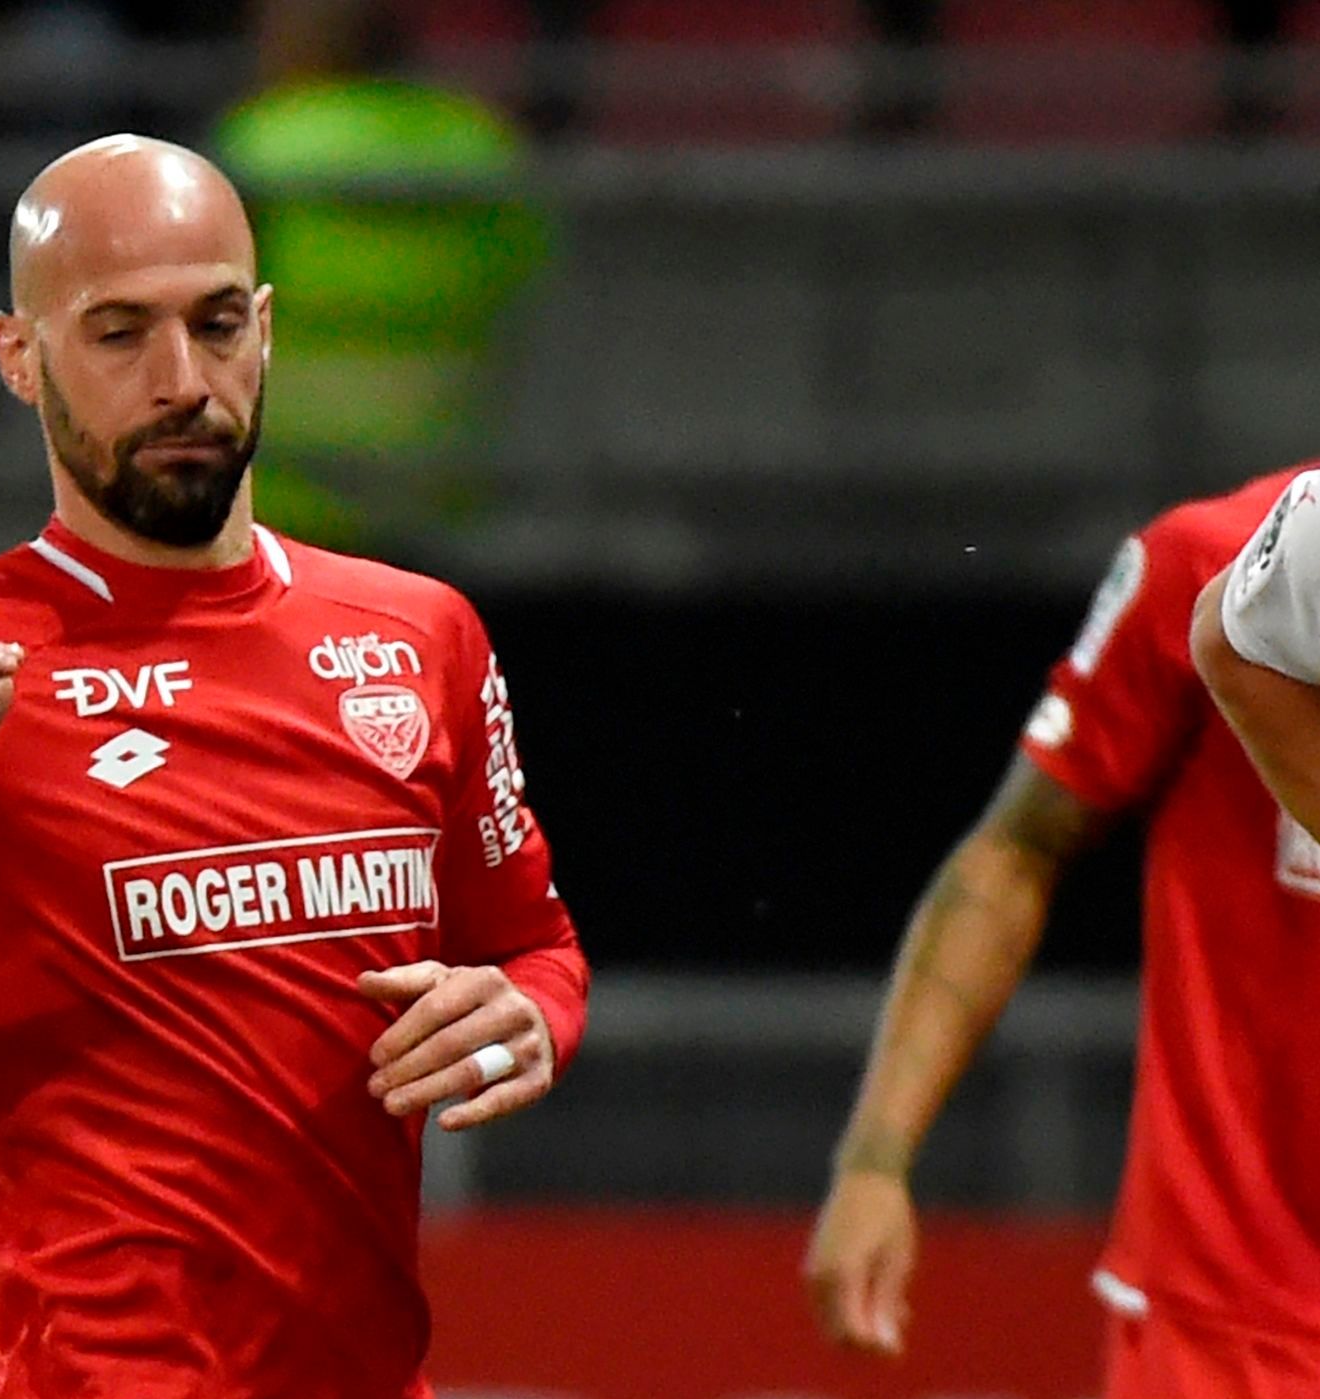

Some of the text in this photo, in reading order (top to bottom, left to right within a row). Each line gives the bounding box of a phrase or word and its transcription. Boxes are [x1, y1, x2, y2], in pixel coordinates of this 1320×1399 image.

[51, 660, 193, 717] DVF
[124, 847, 432, 941] ROGER MARTIN
